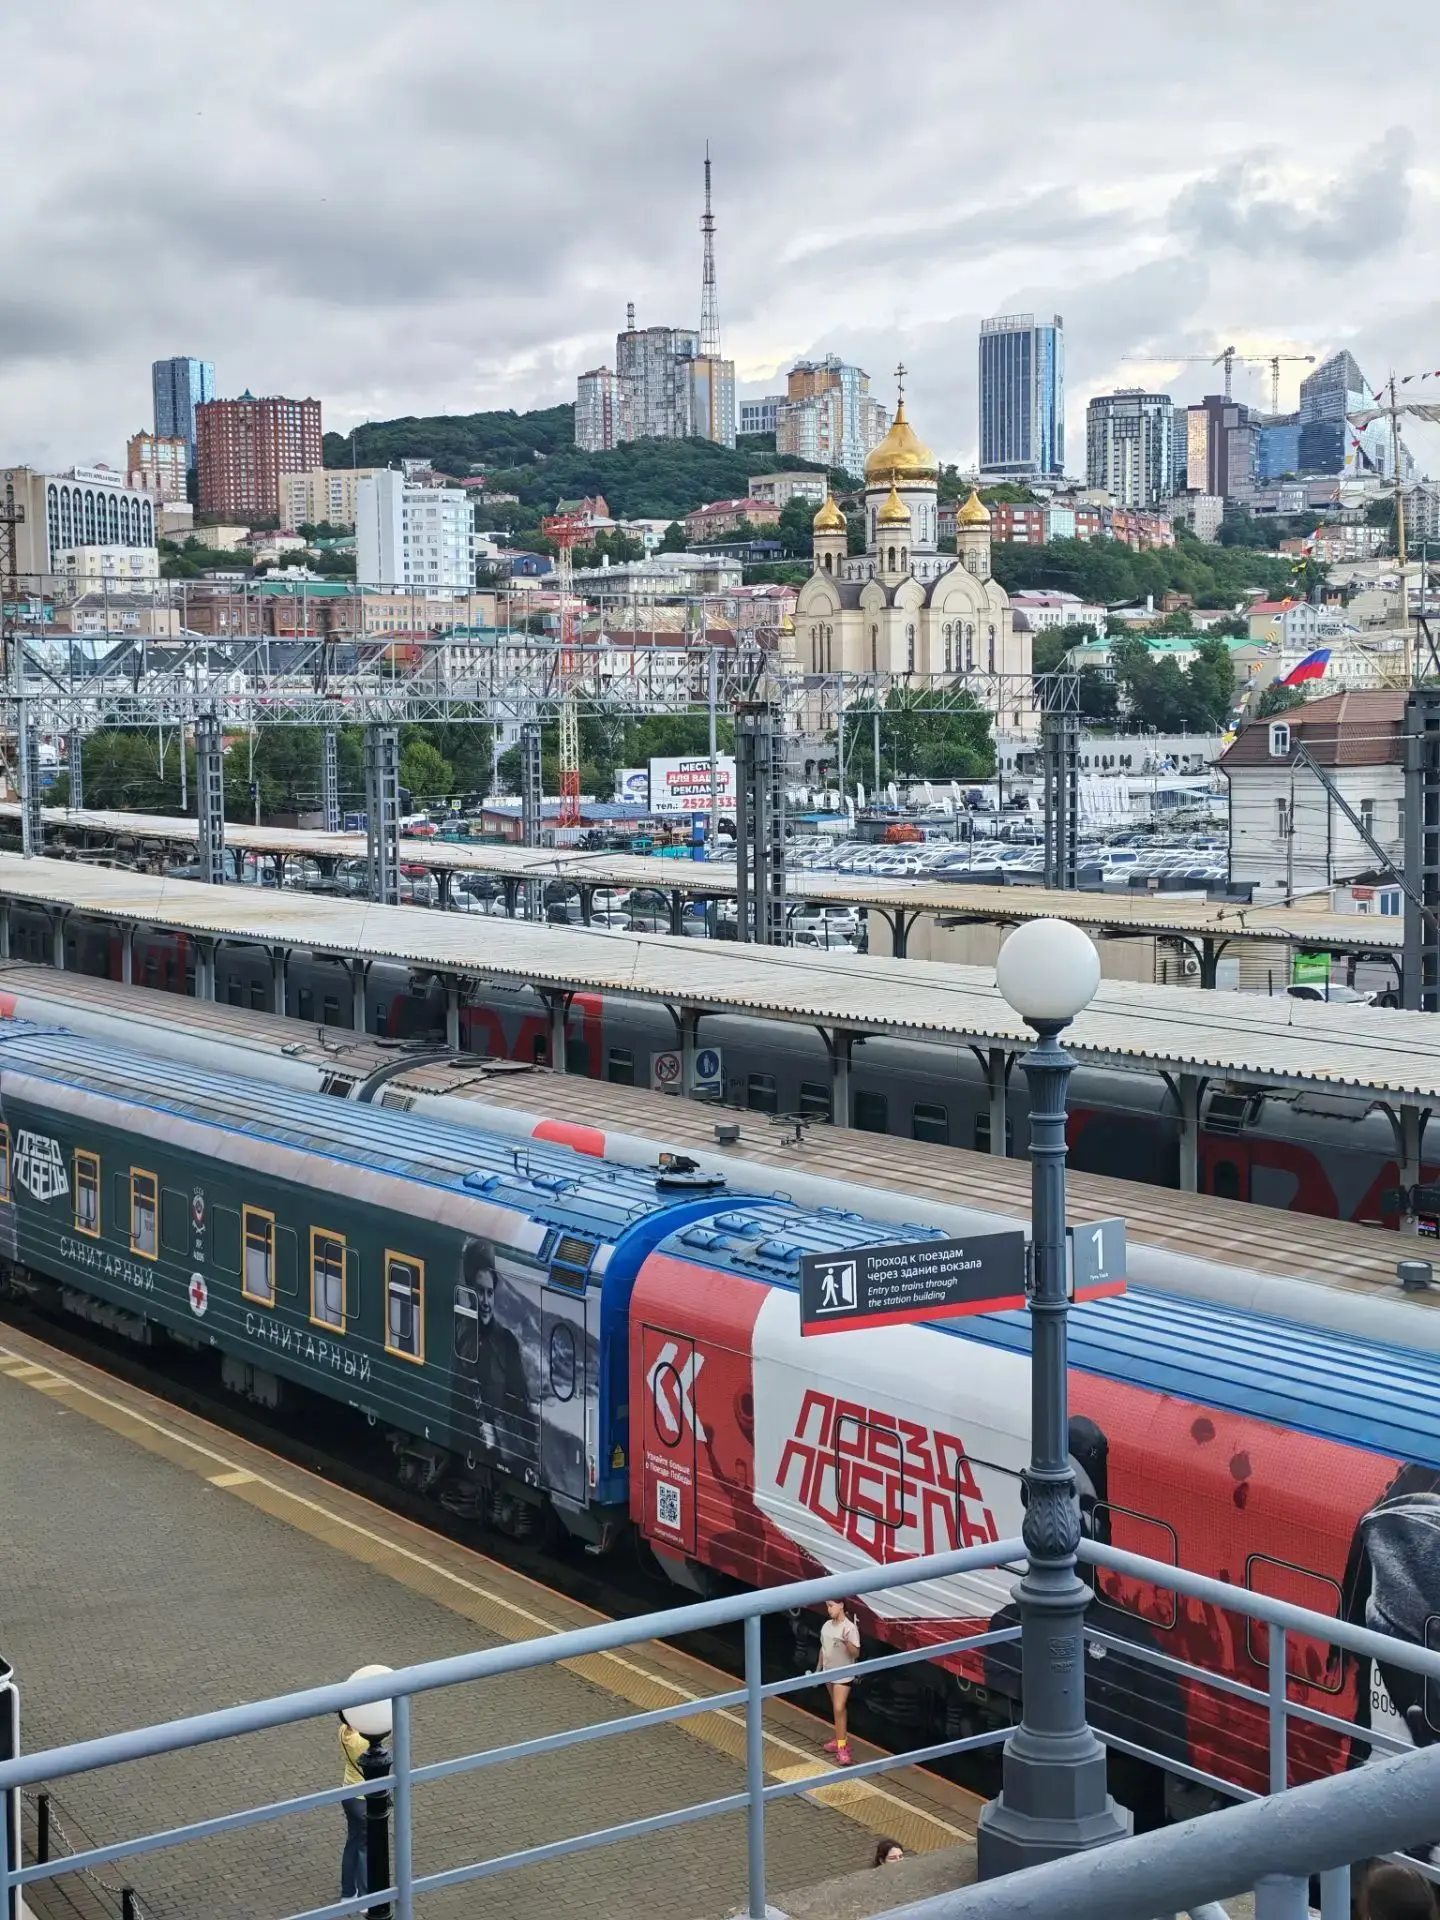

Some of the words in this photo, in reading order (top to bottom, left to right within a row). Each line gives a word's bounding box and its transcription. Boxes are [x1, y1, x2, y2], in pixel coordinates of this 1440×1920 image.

[669, 774, 690, 783] ДЛЯ
[656, 802, 678, 810] тел.:
[16, 1129, 64, 1167] ПОЕЗД
[12, 1152, 69, 1200] ПОБЕДЫ
[61, 1236, 154, 1292] САНИТАРНЫЙ
[867, 1256, 908, 1270] Проход
[910, 1254, 916, 1263] к
[919, 1249, 963, 1261] поездам
[1092, 1228, 1103, 1270] 1
[867, 1270, 898, 1283] через
[900, 1264, 938, 1278] здание
[940, 1259, 982, 1273] вокзала
[868, 1286, 889, 1296] Entry
[891, 1285, 899, 1293] to
[902, 1281, 924, 1291] trains
[925, 1276, 958, 1288] through
[868, 1299, 883, 1308] the
[883, 1295, 911, 1305] station
[913, 1291, 945, 1302] building
[245, 1313, 371, 1383] САНИТАРНЫЙ
[794, 1389, 984, 1502] ПОЕЗД
[775, 1439, 1000, 1566] ПОБЕДЫ
